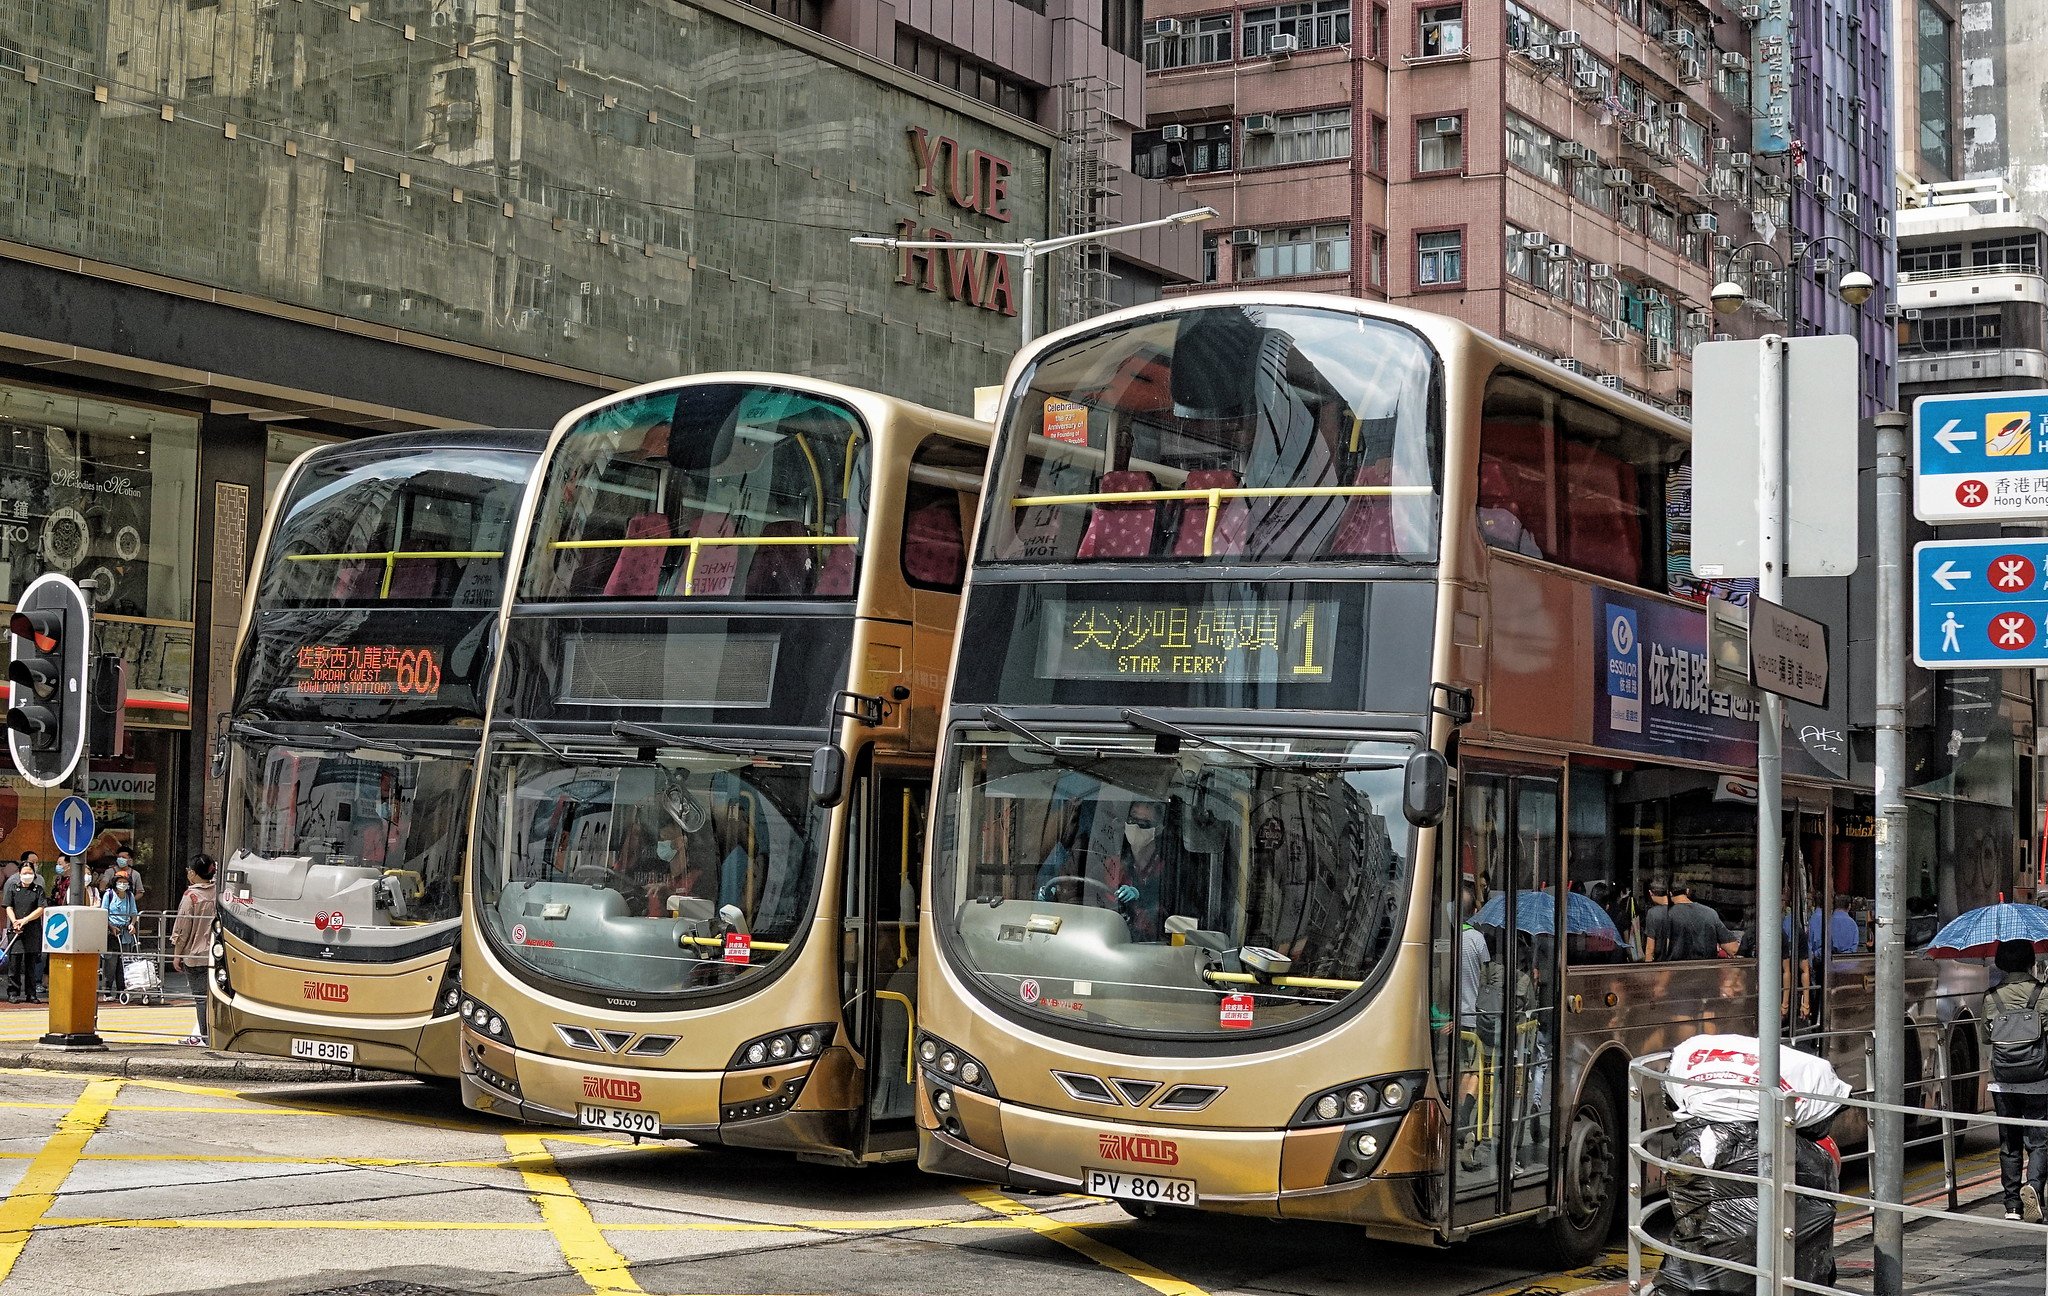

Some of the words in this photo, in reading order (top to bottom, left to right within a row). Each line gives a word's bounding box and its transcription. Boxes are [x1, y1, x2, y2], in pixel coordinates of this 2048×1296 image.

[907, 126, 1012, 223] YUE
[895, 218, 1018, 317] HWA
[1047, 402, 1085, 413] Celebrating
[96, 482, 103, 492] in
[103, 476, 141, 498] Motion
[1995, 476, 2048, 494] 香港西
[1994, 496, 2022, 508] Hong
[1072, 605, 1281, 651] 尖沙咀碼頭
[1292, 603, 1323, 675] 1
[297, 646, 401, 669] 佐敦西九龍站
[1117, 655, 1161, 674] STAR
[1172, 655, 1228, 674] FERRY
[311, 669, 346, 681] JORDAN
[349, 669, 381, 681] (WEST
[297, 681, 341, 693] KOWLOON
[344, 683, 392, 694] STATION)
[316, 982, 350, 1003] KMB
[606, 997, 637, 1007] VOLVO
[297, 1040, 314, 1056] UH
[318, 1041, 349, 1060] 8316
[599, 1078, 642, 1103] KMB
[586, 1105, 606, 1126] UR
[613, 1108, 655, 1132] 5690
[1121, 1135, 1179, 1166] KMB
[1092, 1171, 1120, 1196] PV
[1131, 1176, 1191, 1203] 8048
